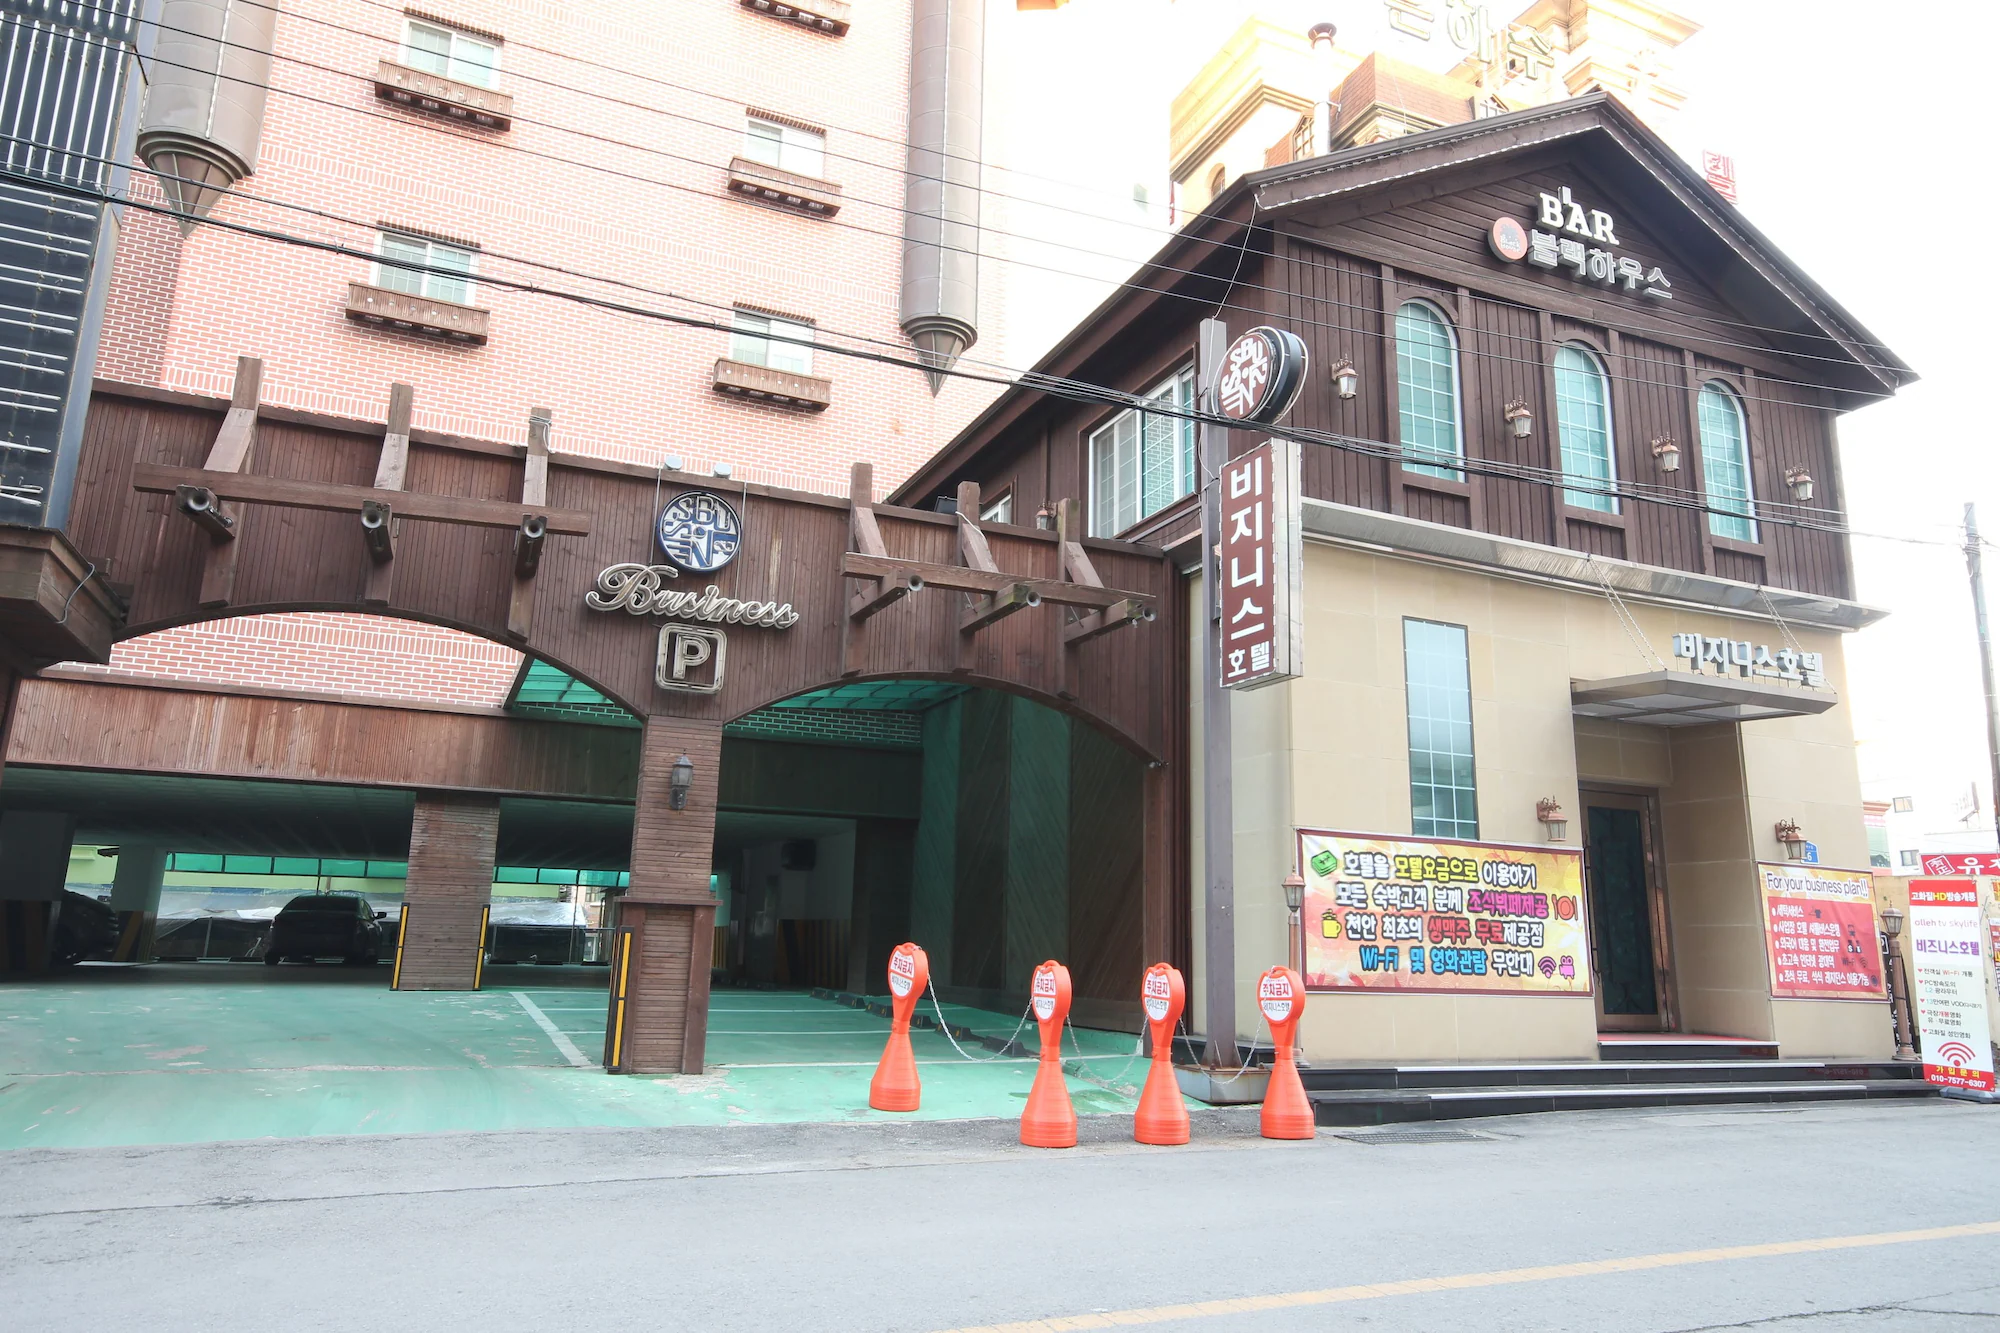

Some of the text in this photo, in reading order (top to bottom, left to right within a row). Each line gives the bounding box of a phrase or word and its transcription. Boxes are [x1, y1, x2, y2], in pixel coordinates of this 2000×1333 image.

[1537, 191, 1620, 246] BAR
[1528, 228, 1673, 300] 블랙하우스
[1230, 455, 1265, 641] 비지니스
[585, 562, 800, 630] Business
[672, 632, 711, 680] P
[1227, 640, 1270, 679] 호텔
[1343, 851, 1537, 890] 호텔을 모텔요금으로 이용하기
[1766, 872, 1782, 889] For
[1785, 878, 1804, 892] your
[1804, 876, 1842, 894] business
[1335, 880, 1368, 910] 모든
[1372, 882, 1429, 913] 숙박고객
[1467, 888, 1549, 919] 조식뷔페제공
[1345, 913, 1545, 948] 천안 최초의 생맥주 무료제공점
[1914, 919, 1978, 929] olleh tv skylife
[1359, 944, 1534, 977] Wi-Fi 및 영화관람 무한대
[1916, 939, 1980, 956] 비즈니스호텔
[1931, 1073, 1986, 1089] 010-7577-6307
